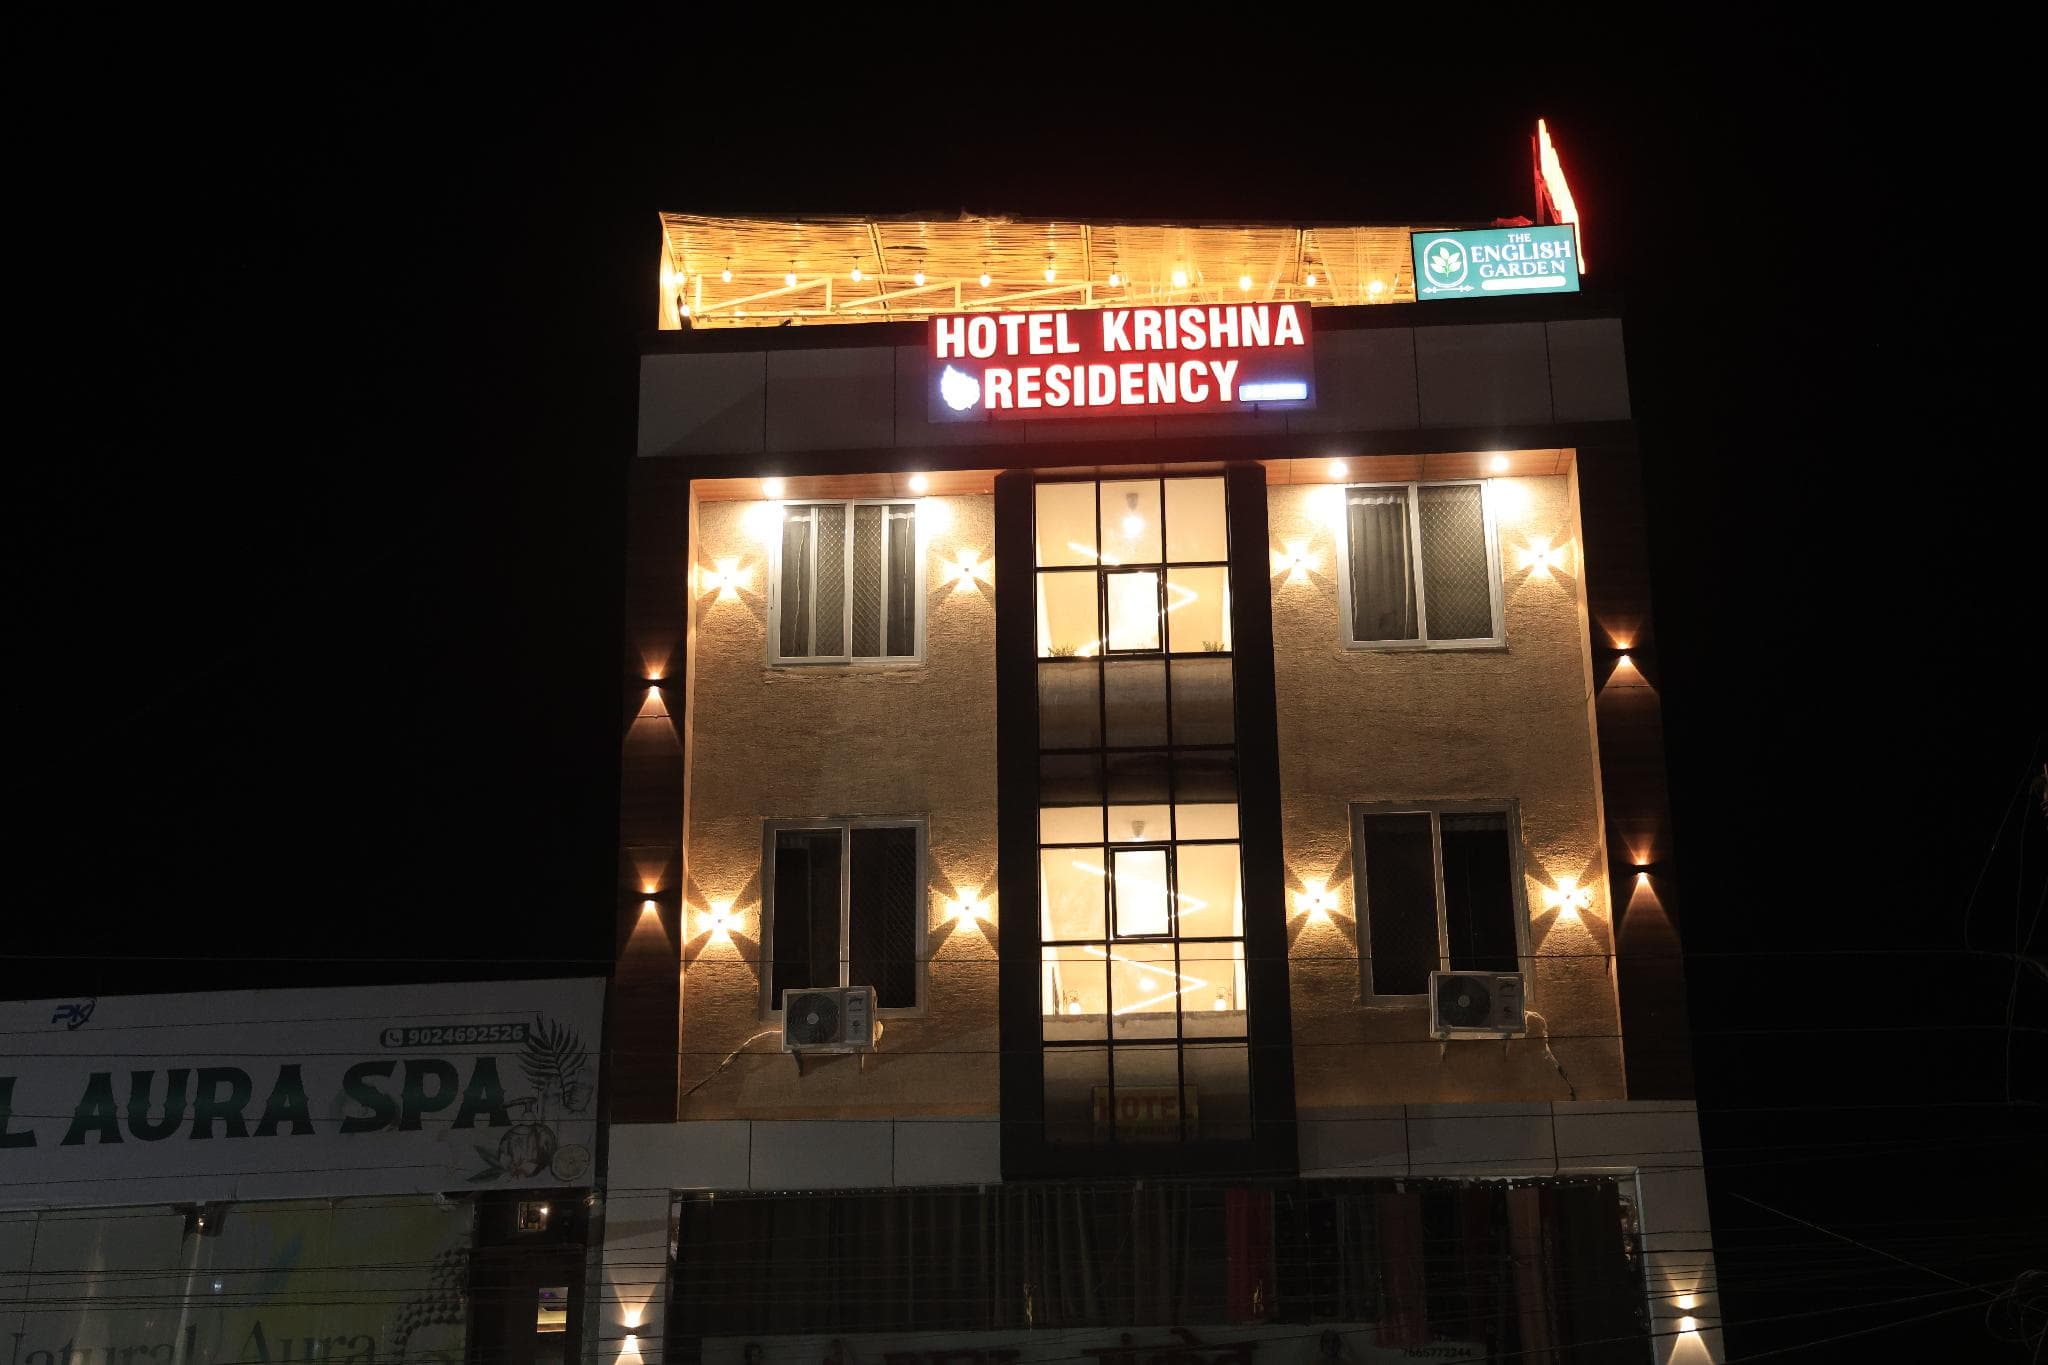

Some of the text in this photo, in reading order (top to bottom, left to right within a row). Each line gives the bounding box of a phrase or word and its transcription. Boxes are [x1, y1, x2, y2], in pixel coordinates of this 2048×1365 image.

[1507, 233, 1531, 243] THE
[1470, 240, 1572, 263] ENGLISH
[1479, 259, 1566, 278] GARDEN
[936, 304, 1304, 359] HOTEL KRISHNA
[984, 359, 1239, 409] RESIDENCY
[408, 1026, 524, 1044] 9024692526
[60, 1063, 315, 1146] AURA
[338, 1056, 511, 1135] SPA
